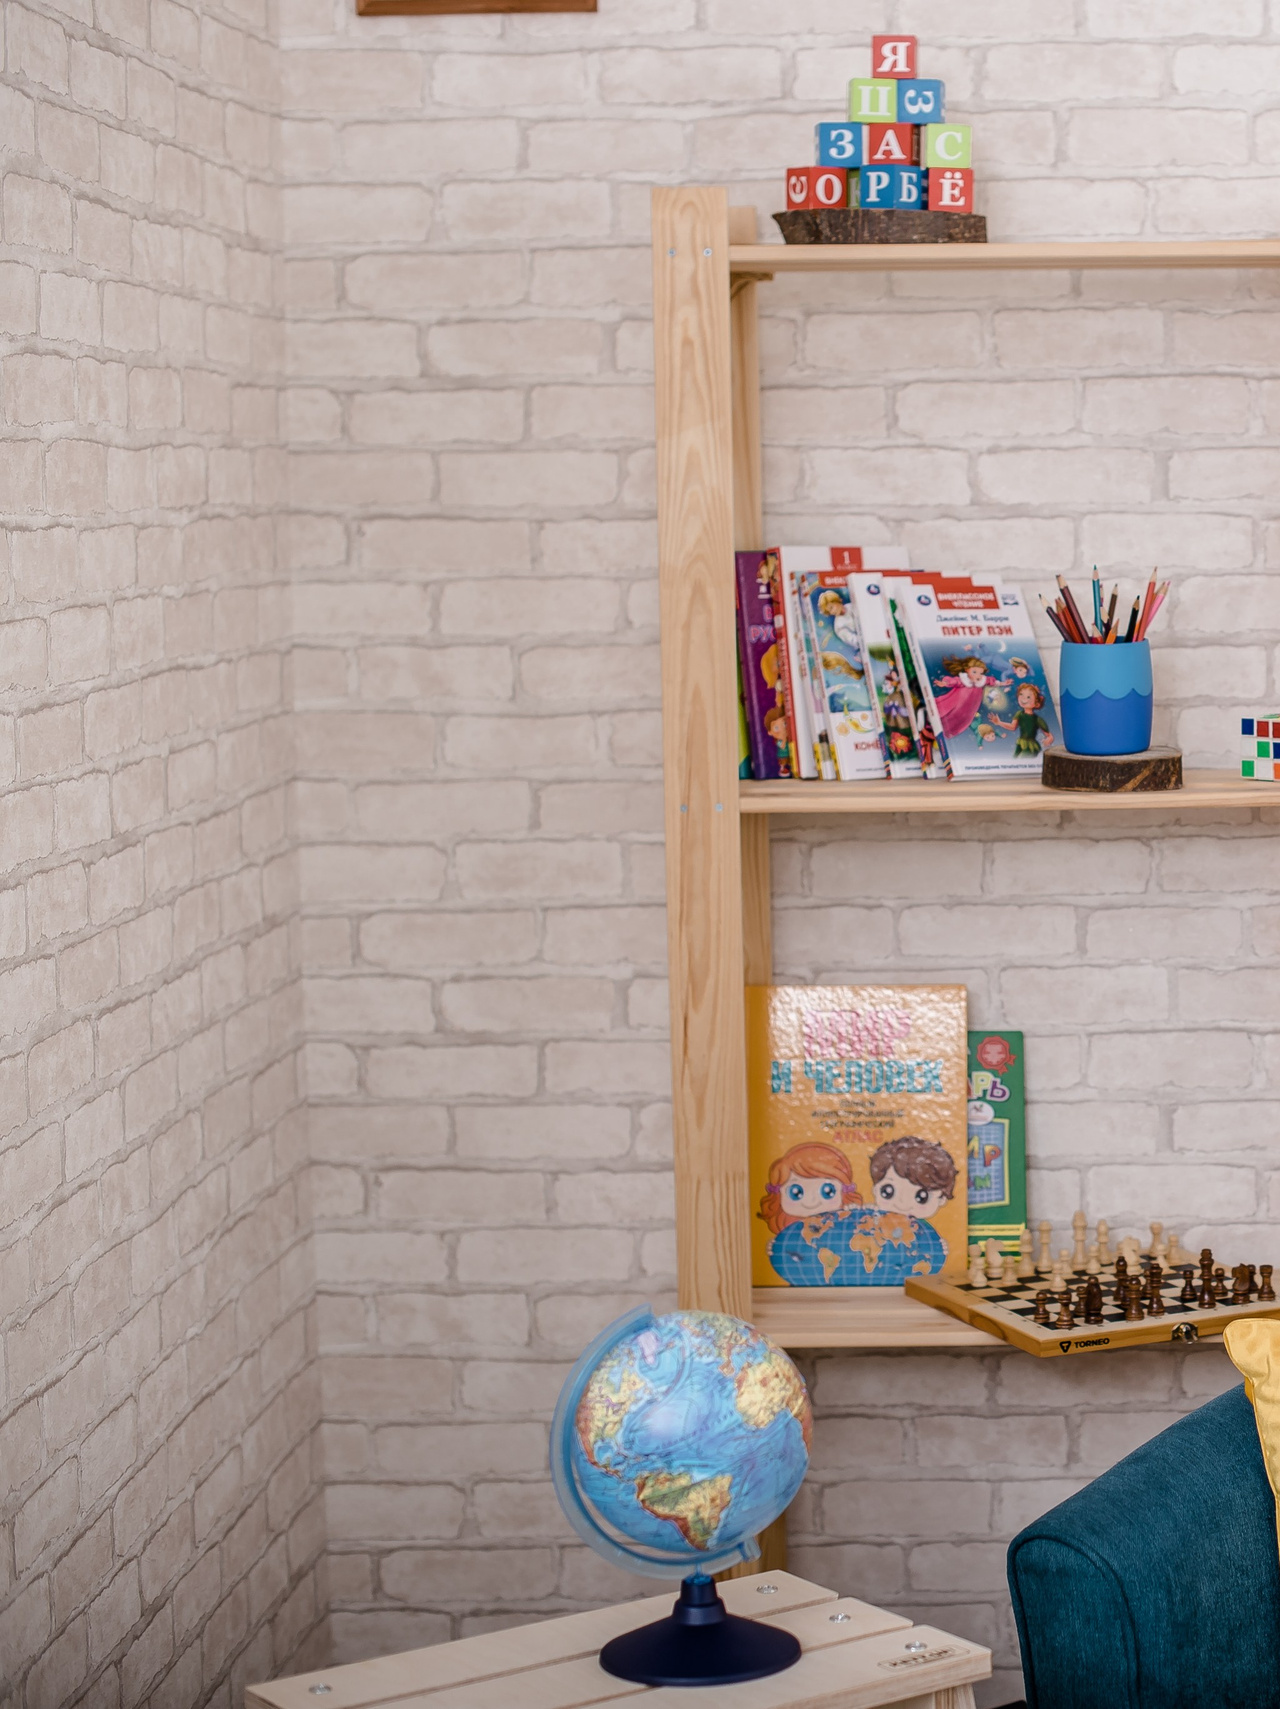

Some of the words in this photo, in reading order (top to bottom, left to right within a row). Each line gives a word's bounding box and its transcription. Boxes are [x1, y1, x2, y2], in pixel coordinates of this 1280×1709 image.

[876, 41, 911, 72] Я
[829, 129, 855, 159] З
[872, 129, 907, 160] А
[935, 131, 963, 160] С
[815, 174, 842, 205] О
[866, 171, 890, 202] Р
[899, 171, 918, 202] Б
[939, 171, 965, 206] Ё
[942, 625, 982, 636] ПИТЕР
[987, 625, 1013, 636] ПЭН
[771, 1060, 792, 1093] И
[804, 1060, 944, 1093] ЧЕЛОВЕК
[1074, 1338, 1110, 1348] TORNEO
